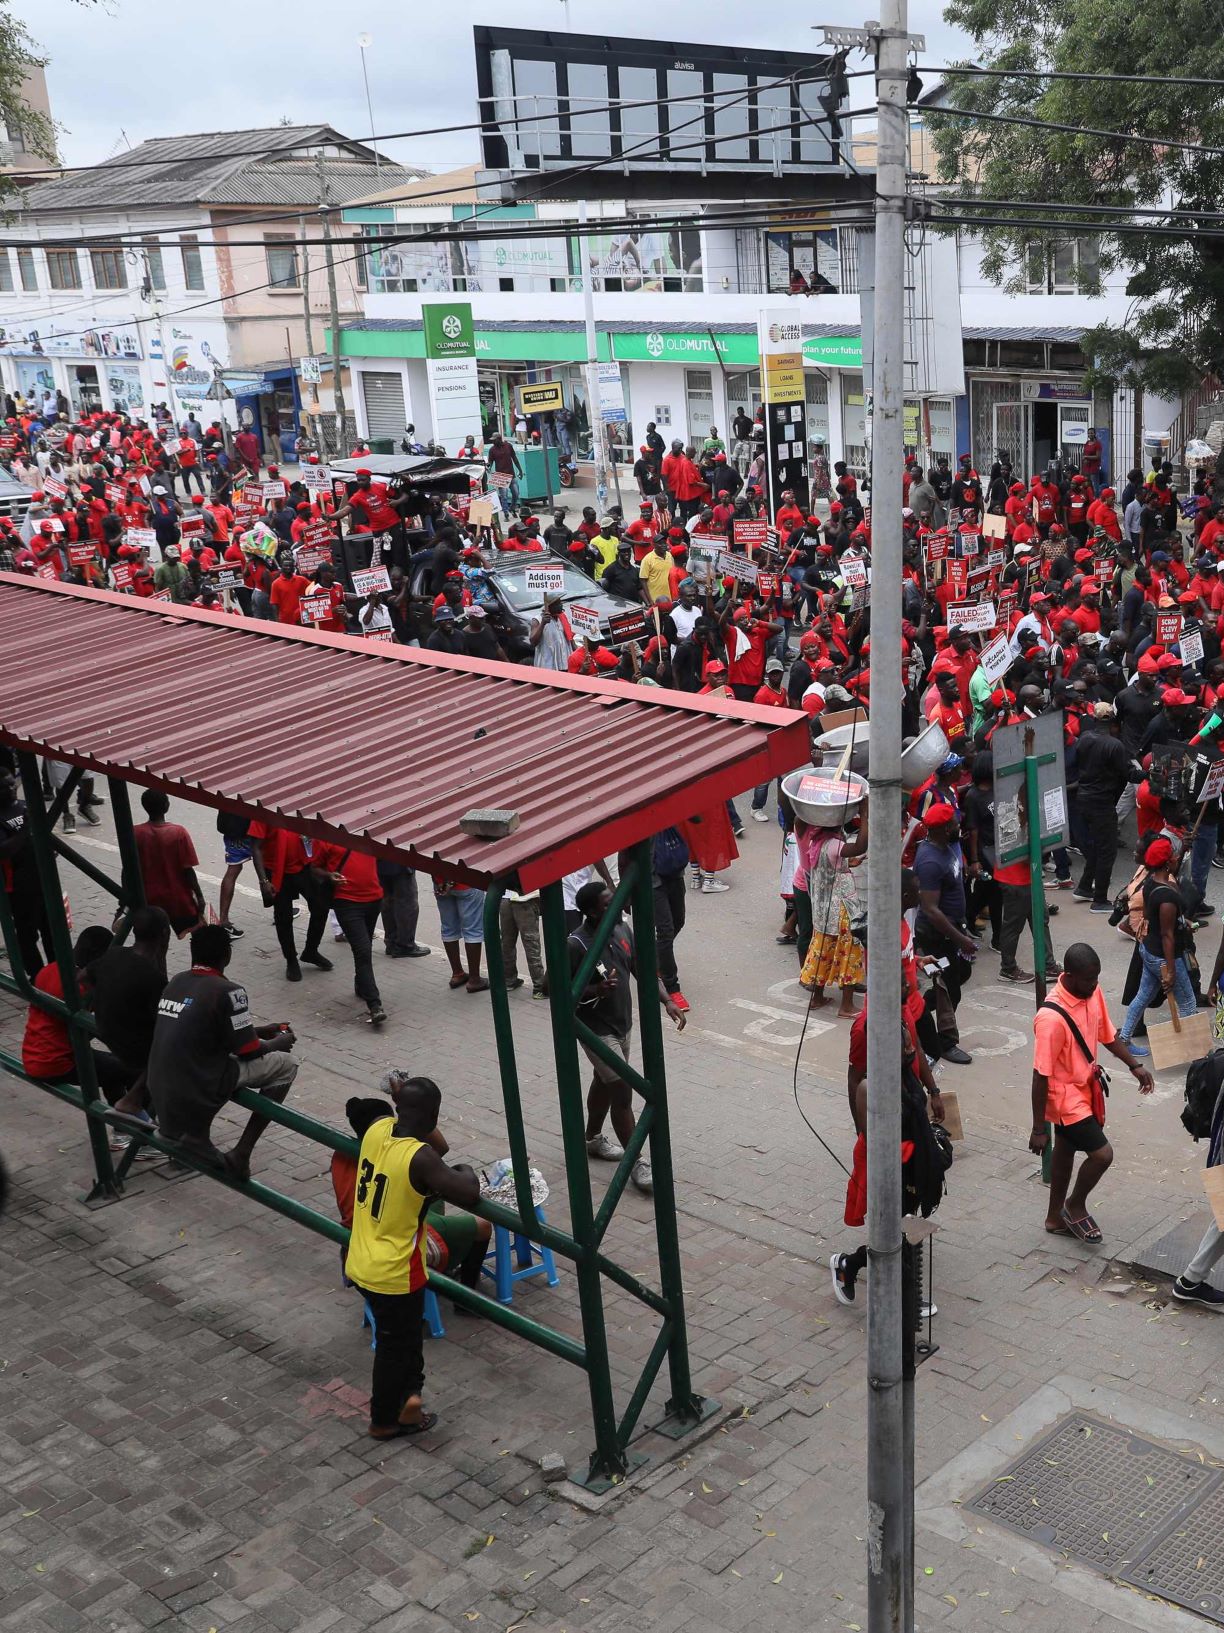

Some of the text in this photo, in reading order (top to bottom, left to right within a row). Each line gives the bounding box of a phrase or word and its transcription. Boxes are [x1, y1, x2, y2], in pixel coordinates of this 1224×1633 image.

[674, 61, 695, 71] aluvisa
[780, 324, 801, 333] GLOBAL
[780, 331, 801, 341] ACCESS
[666, 338, 729, 352] OLDMUTUAL
[820, 346, 839, 356] your
[435, 364, 469, 372] INSURANCE
[779, 374, 794, 382] LOANS
[437, 384, 467, 392] PENSIONS
[773, 389, 802, 398] INVESTMENTS
[700, 548, 719, 557] NOW!
[528, 573, 561, 581] Addison
[845, 573, 866, 585] RESIGN
[358, 582, 389, 595] SCAMMER
[527, 581, 563, 590] must go!
[571, 609, 588, 621] Taxes
[950, 608, 978, 619] FAILED
[1161, 618, 1178, 626] SCRAP
[1160, 625, 1178, 633] E-LEVY
[357, 1157, 389, 1221] 31
